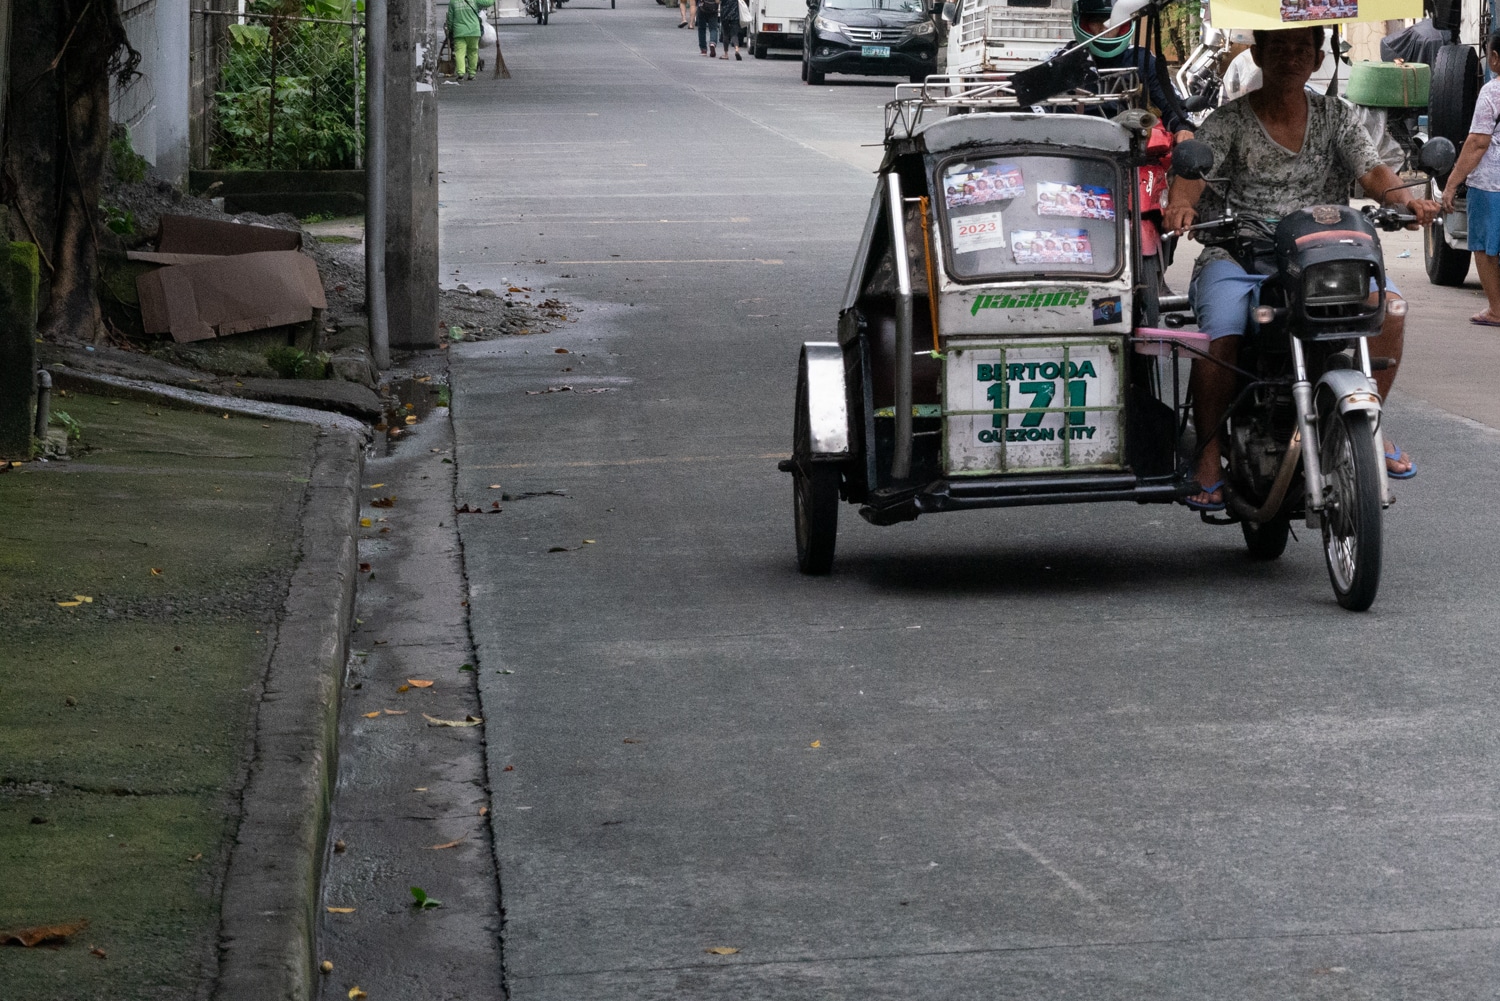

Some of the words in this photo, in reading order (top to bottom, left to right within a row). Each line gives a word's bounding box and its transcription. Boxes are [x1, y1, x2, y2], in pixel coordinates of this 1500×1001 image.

[959, 222, 997, 235] 2023
[977, 360, 1097, 382] BERTODA
[987, 379, 1087, 429] 171
[978, 427, 1055, 443] QUEZON
[1057, 426, 1097, 440] CITY
